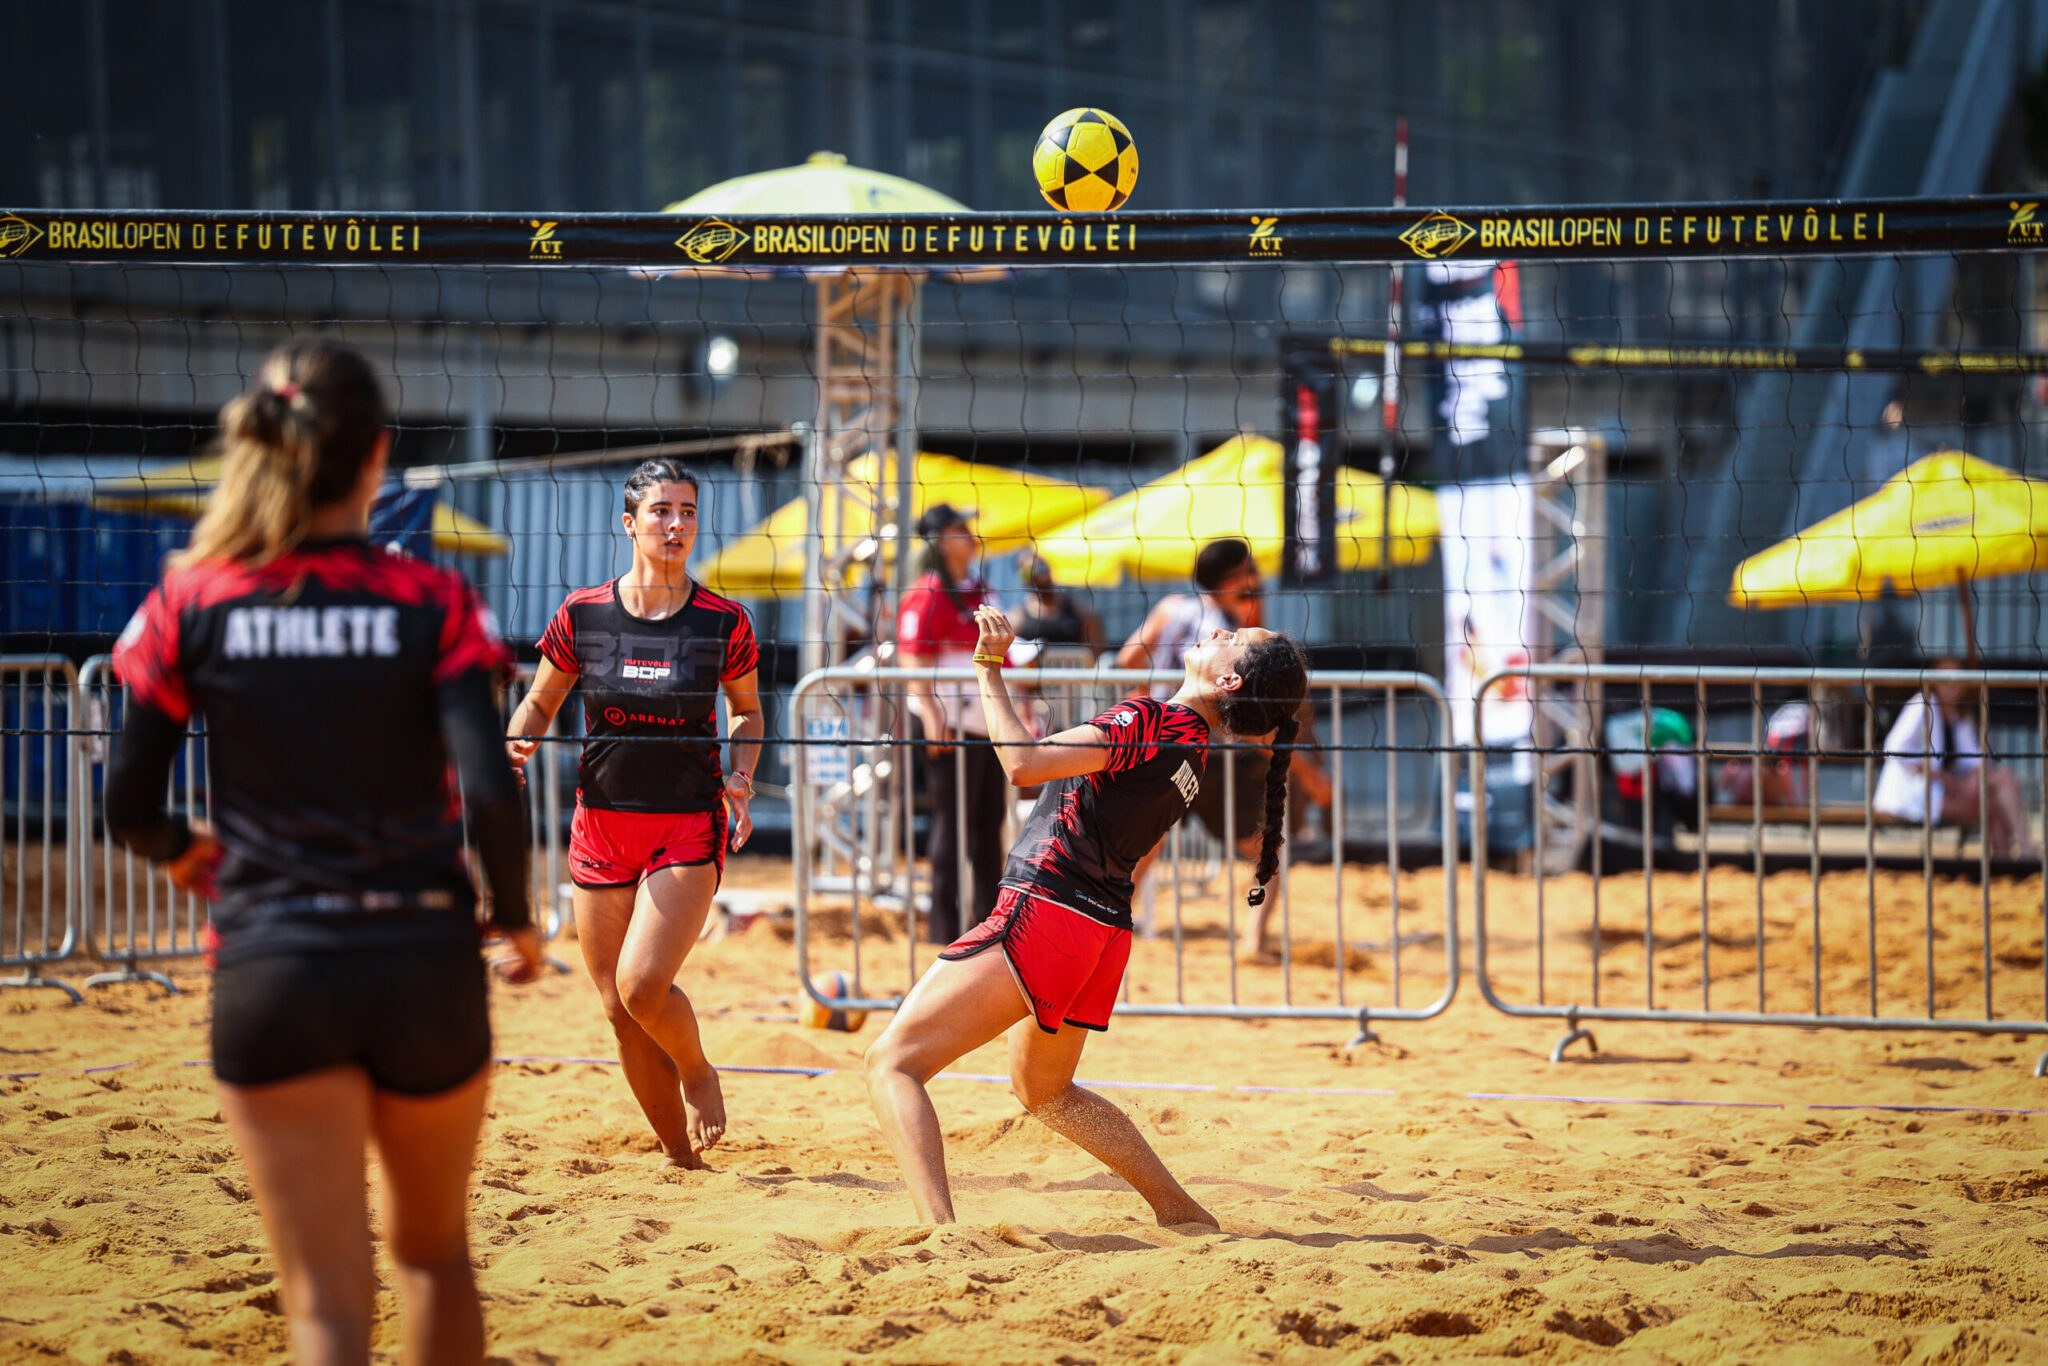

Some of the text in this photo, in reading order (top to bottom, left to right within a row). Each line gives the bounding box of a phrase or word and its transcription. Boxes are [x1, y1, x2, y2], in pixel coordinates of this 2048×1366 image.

[223, 605, 400, 659] ATHLETE
[622, 665, 671, 680] BOP
[629, 713, 686, 726] ARENA7
